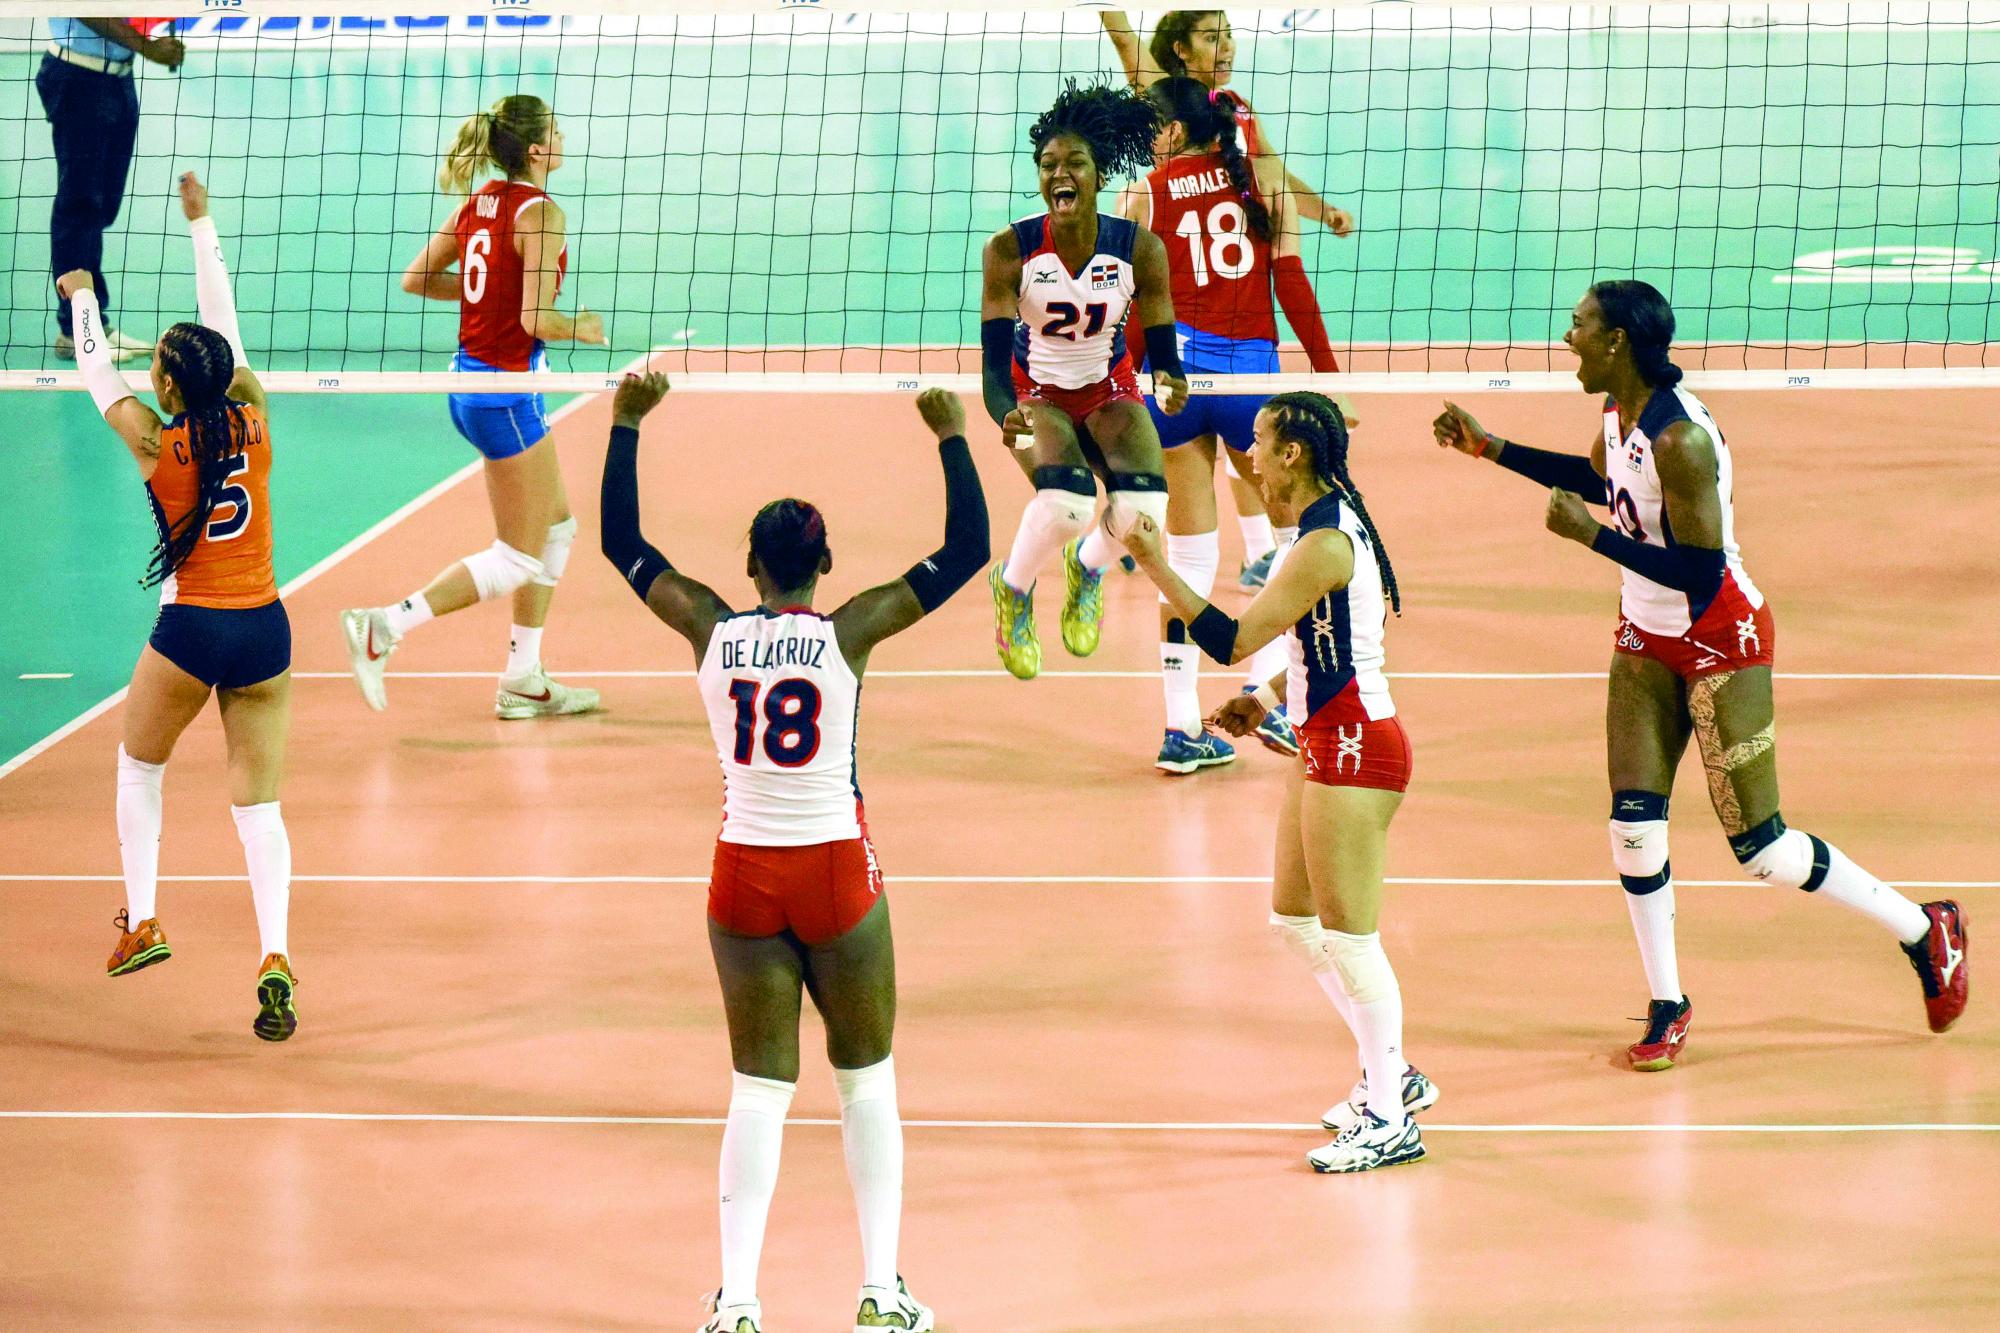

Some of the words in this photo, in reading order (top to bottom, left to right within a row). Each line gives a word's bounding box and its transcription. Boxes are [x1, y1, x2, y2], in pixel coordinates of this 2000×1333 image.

[1168, 168, 1233, 201] MORALE
[463, 229, 492, 304] 6
[1176, 201, 1255, 287] 18
[1041, 301, 1108, 341] 21
[205, 451, 252, 541] 5
[722, 639, 746, 669] DE
[728, 677, 822, 768] 18
